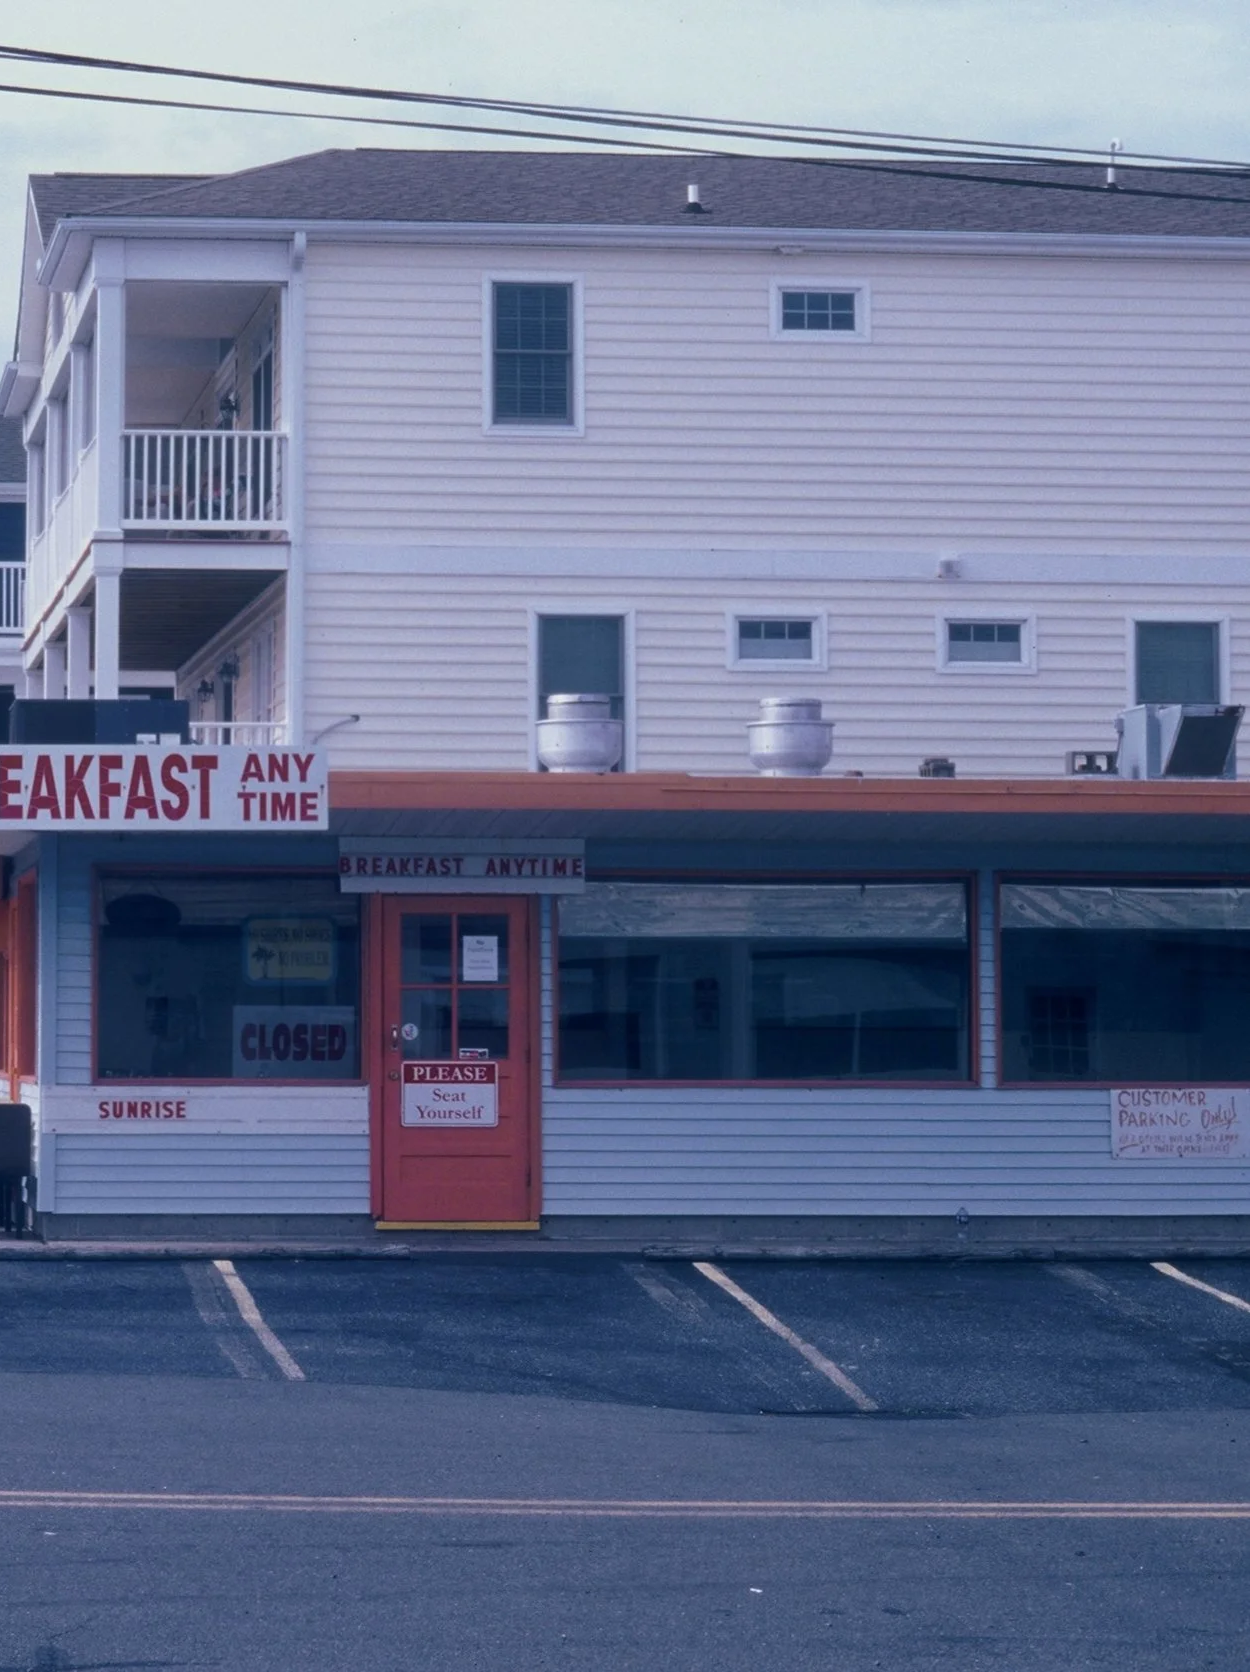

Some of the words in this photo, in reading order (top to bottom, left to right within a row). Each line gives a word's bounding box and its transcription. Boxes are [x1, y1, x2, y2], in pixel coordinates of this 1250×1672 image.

[240, 753, 315, 783] ANY
[237, 792, 319, 822] TIME
[339, 856, 465, 876] BREAKFAST
[485, 857, 583, 877] ANYTIME
[240, 1022, 347, 1062] CLOSED
[412, 1066, 488, 1081] PLEASE
[432, 1088, 466, 1102] Seat
[1118, 1090, 1206, 1107] CUSTOMER
[99, 1101, 186, 1119] SUNRISE
[415, 1105, 485, 1120] Yourself
[1119, 1109, 1191, 1128] PARKING
